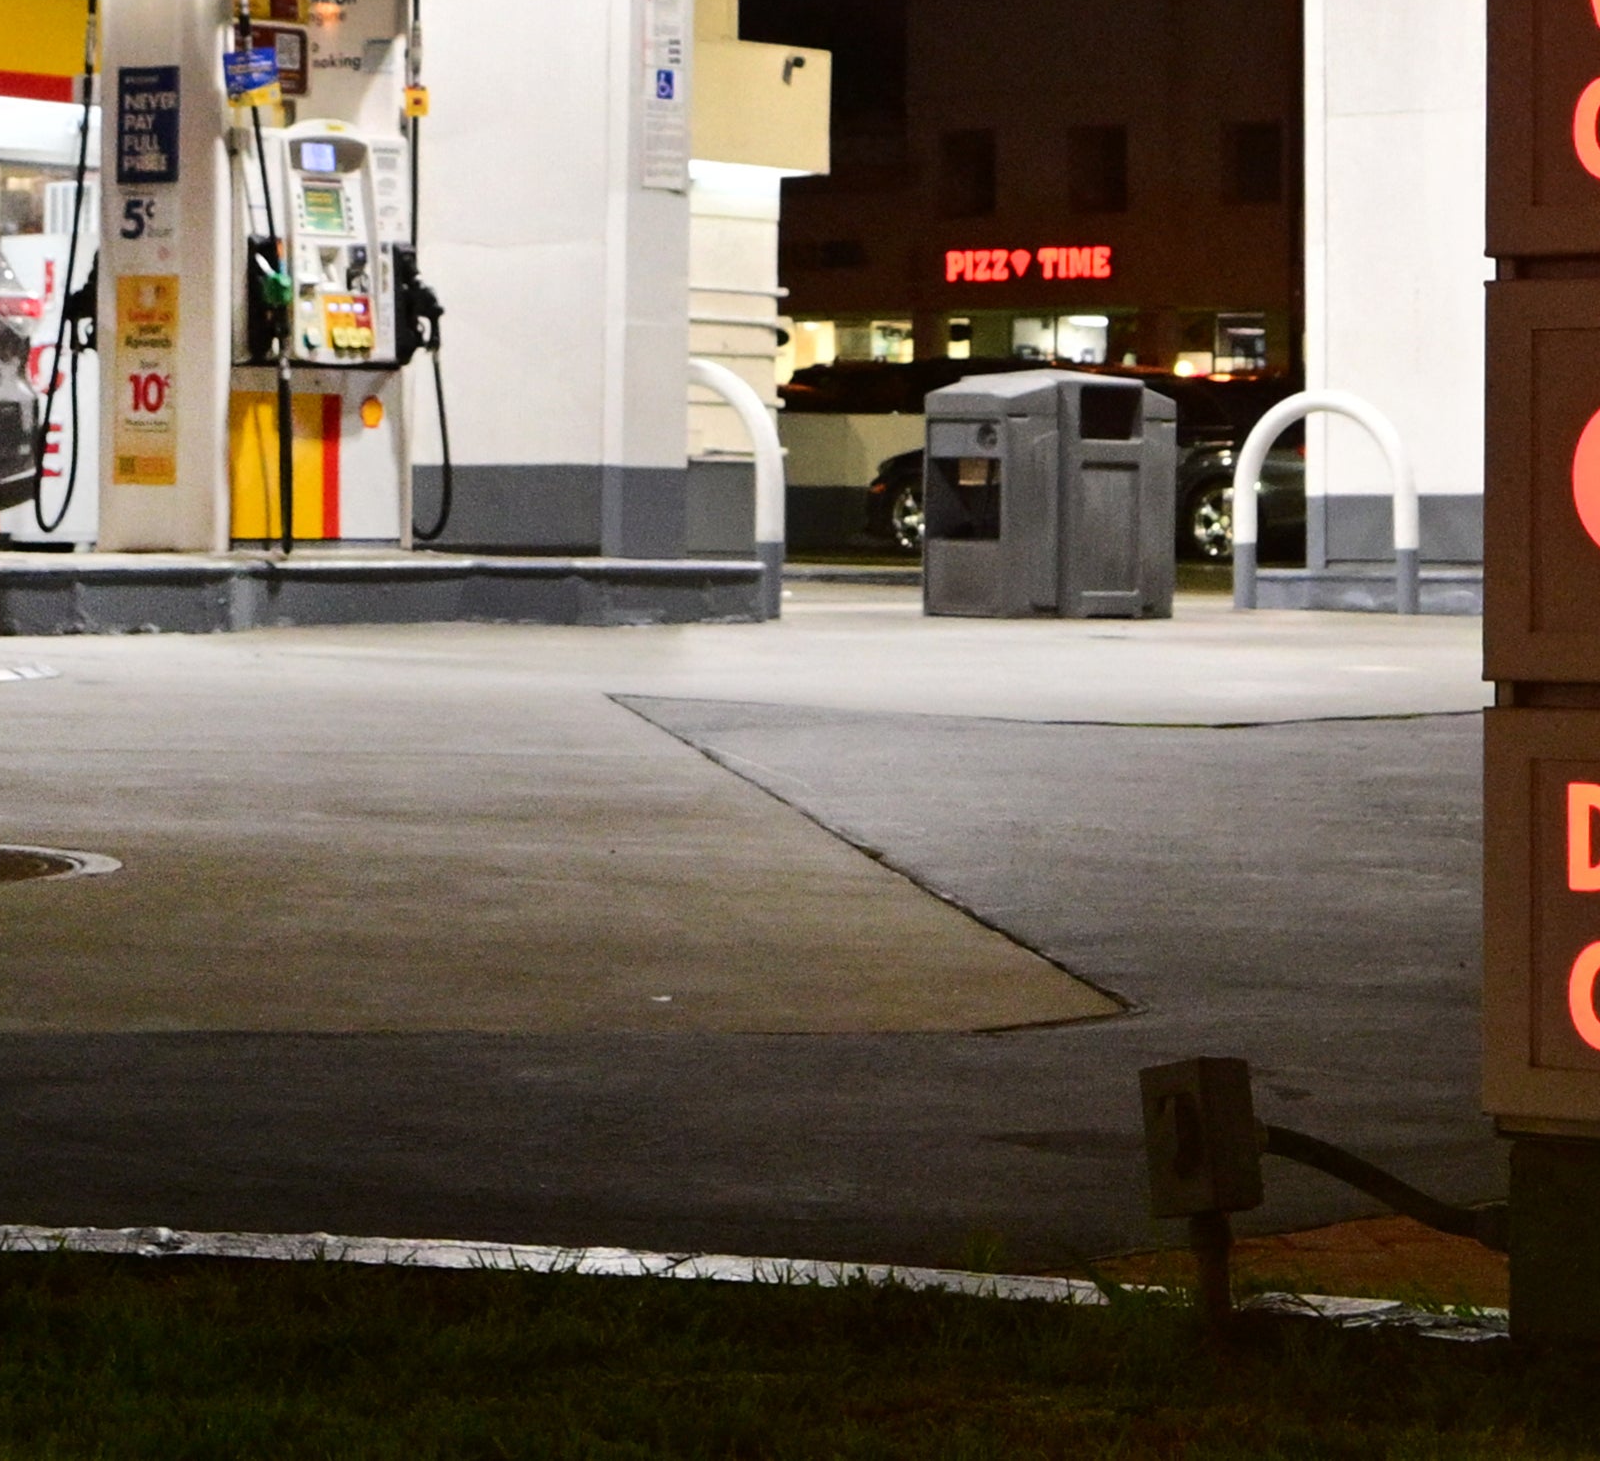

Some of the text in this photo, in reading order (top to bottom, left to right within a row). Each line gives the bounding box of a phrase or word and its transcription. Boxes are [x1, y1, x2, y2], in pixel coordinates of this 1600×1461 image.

[123, 90, 178, 111] NEVER
[123, 112, 156, 131] PAY
[123, 133, 160, 153] FULL
[1037, 245, 1111, 280] TIME
